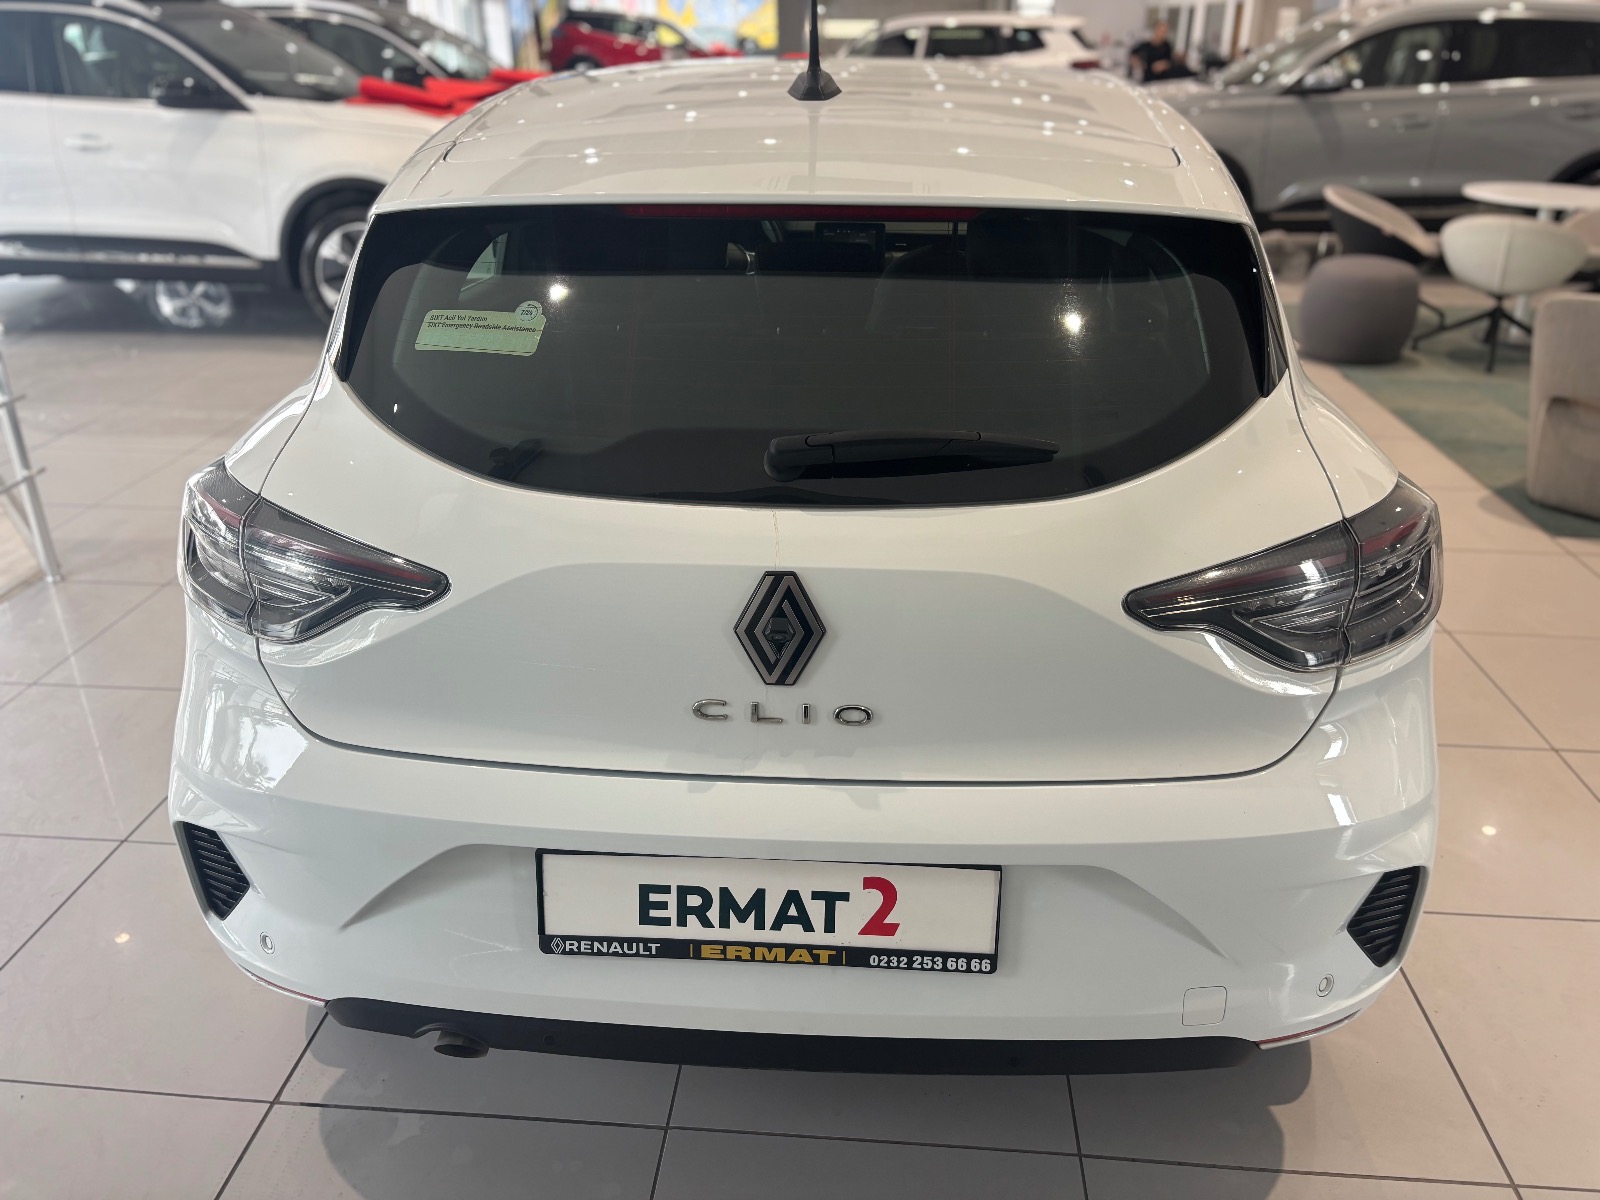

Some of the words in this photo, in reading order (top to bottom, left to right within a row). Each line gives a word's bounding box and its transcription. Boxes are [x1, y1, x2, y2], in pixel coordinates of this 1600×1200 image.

[441, 322, 473, 330] Emergency
[502, 324, 537, 333] Assistance
[692, 698, 874, 727] CLIO
[638, 883, 850, 934] ERMAT
[857, 876, 901, 937] 2
[565, 940, 661, 955] RENAULT
[700, 944, 837, 964] ERMAT
[869, 954, 908, 968] 0232
[912, 955, 943, 970] 253
[946, 957, 968, 971] 66
[970, 958, 991, 972] 66
